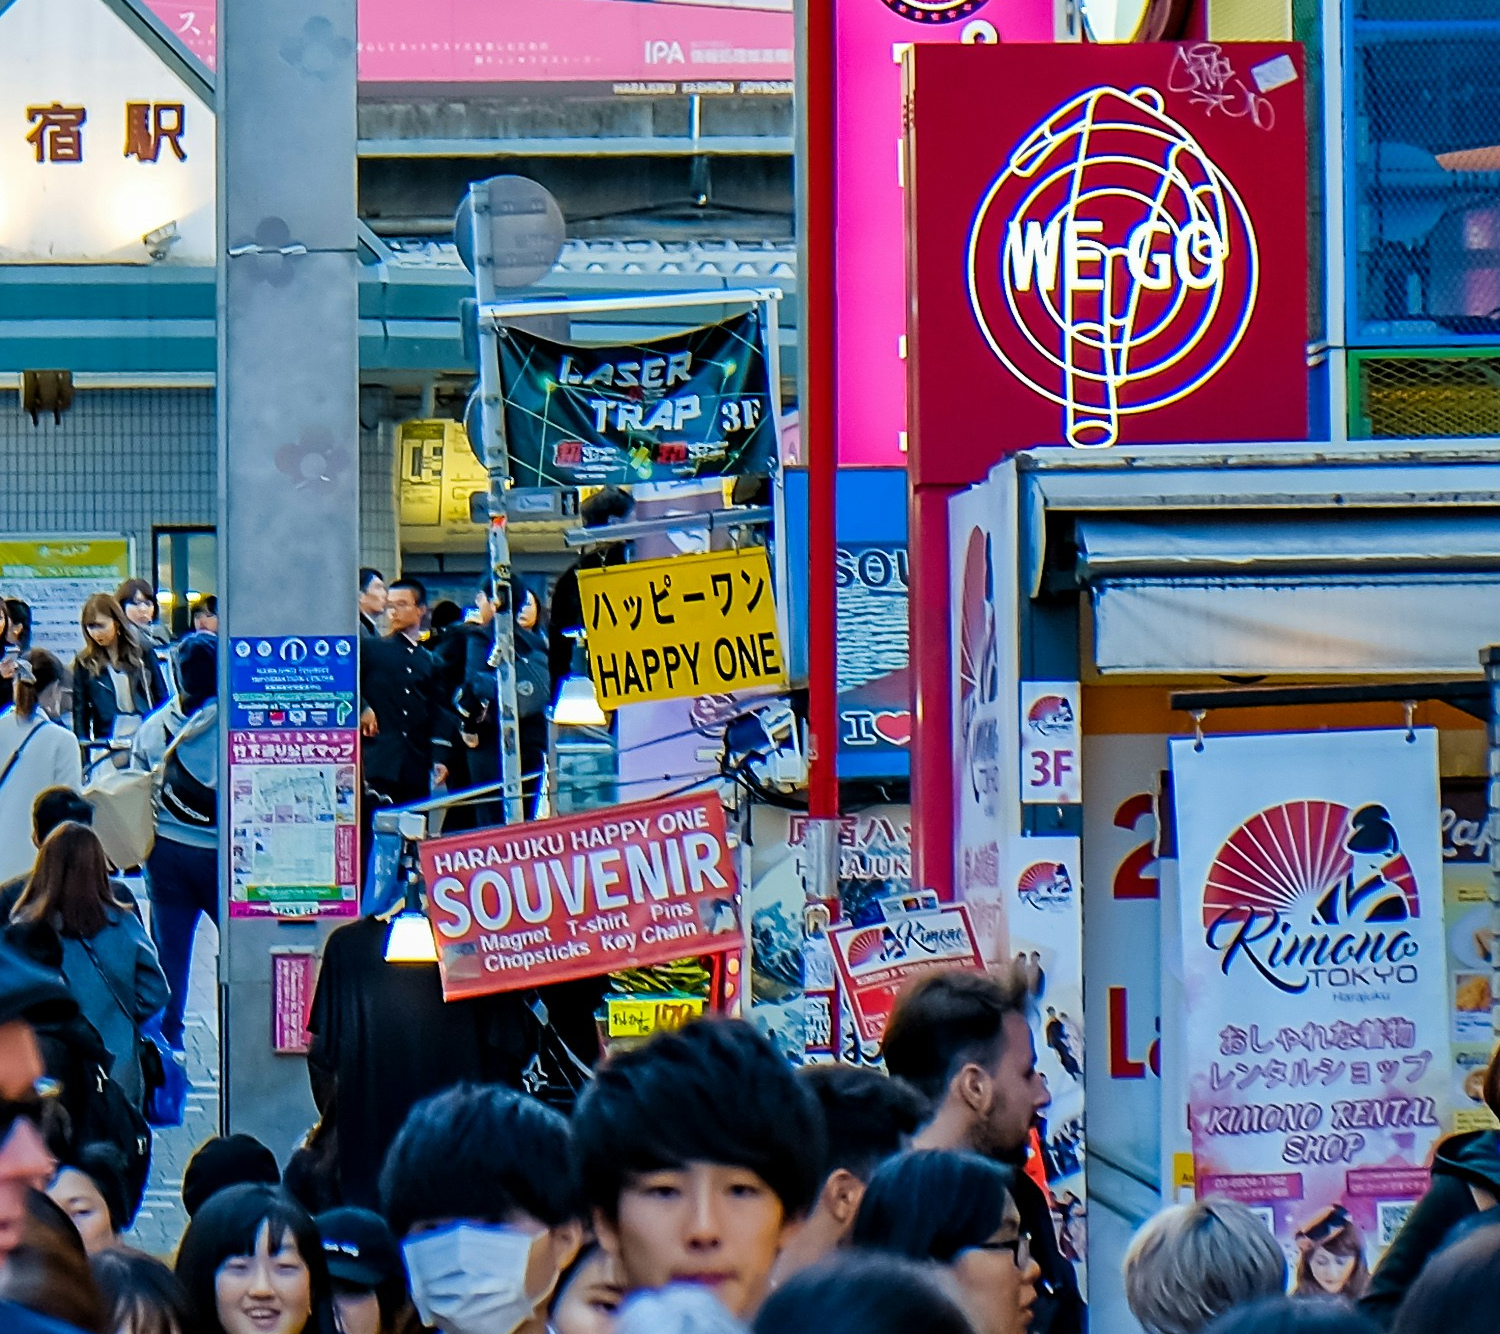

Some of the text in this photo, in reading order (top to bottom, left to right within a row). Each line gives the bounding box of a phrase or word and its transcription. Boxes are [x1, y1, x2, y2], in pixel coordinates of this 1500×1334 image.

[644, 40, 685, 65] IPA
[558, 350, 693, 388] LASER
[591, 394, 702, 434] TRAP
[592, 569, 765, 631] ハッピーワン
[597, 631, 781, 698] HAPPY ONE
[1031, 750, 1074, 787] 3F
[434, 806, 710, 875] HARAJUKU HAPPY ONE
[432, 831, 729, 939] SOUVENIR
[480, 901, 694, 955] Magnet T-shirt Pins
[483, 919, 699, 974] Chopsticks Key Chain
[1205, 904, 1419, 995] Kimono
[1306, 964, 1419, 988] TOKYO
[1209, 1050, 1433, 1091] レンタルショップ
[1206, 1096, 1440, 1137] KIMONO RENTAL
[1281, 1132, 1366, 1165] SHOP
